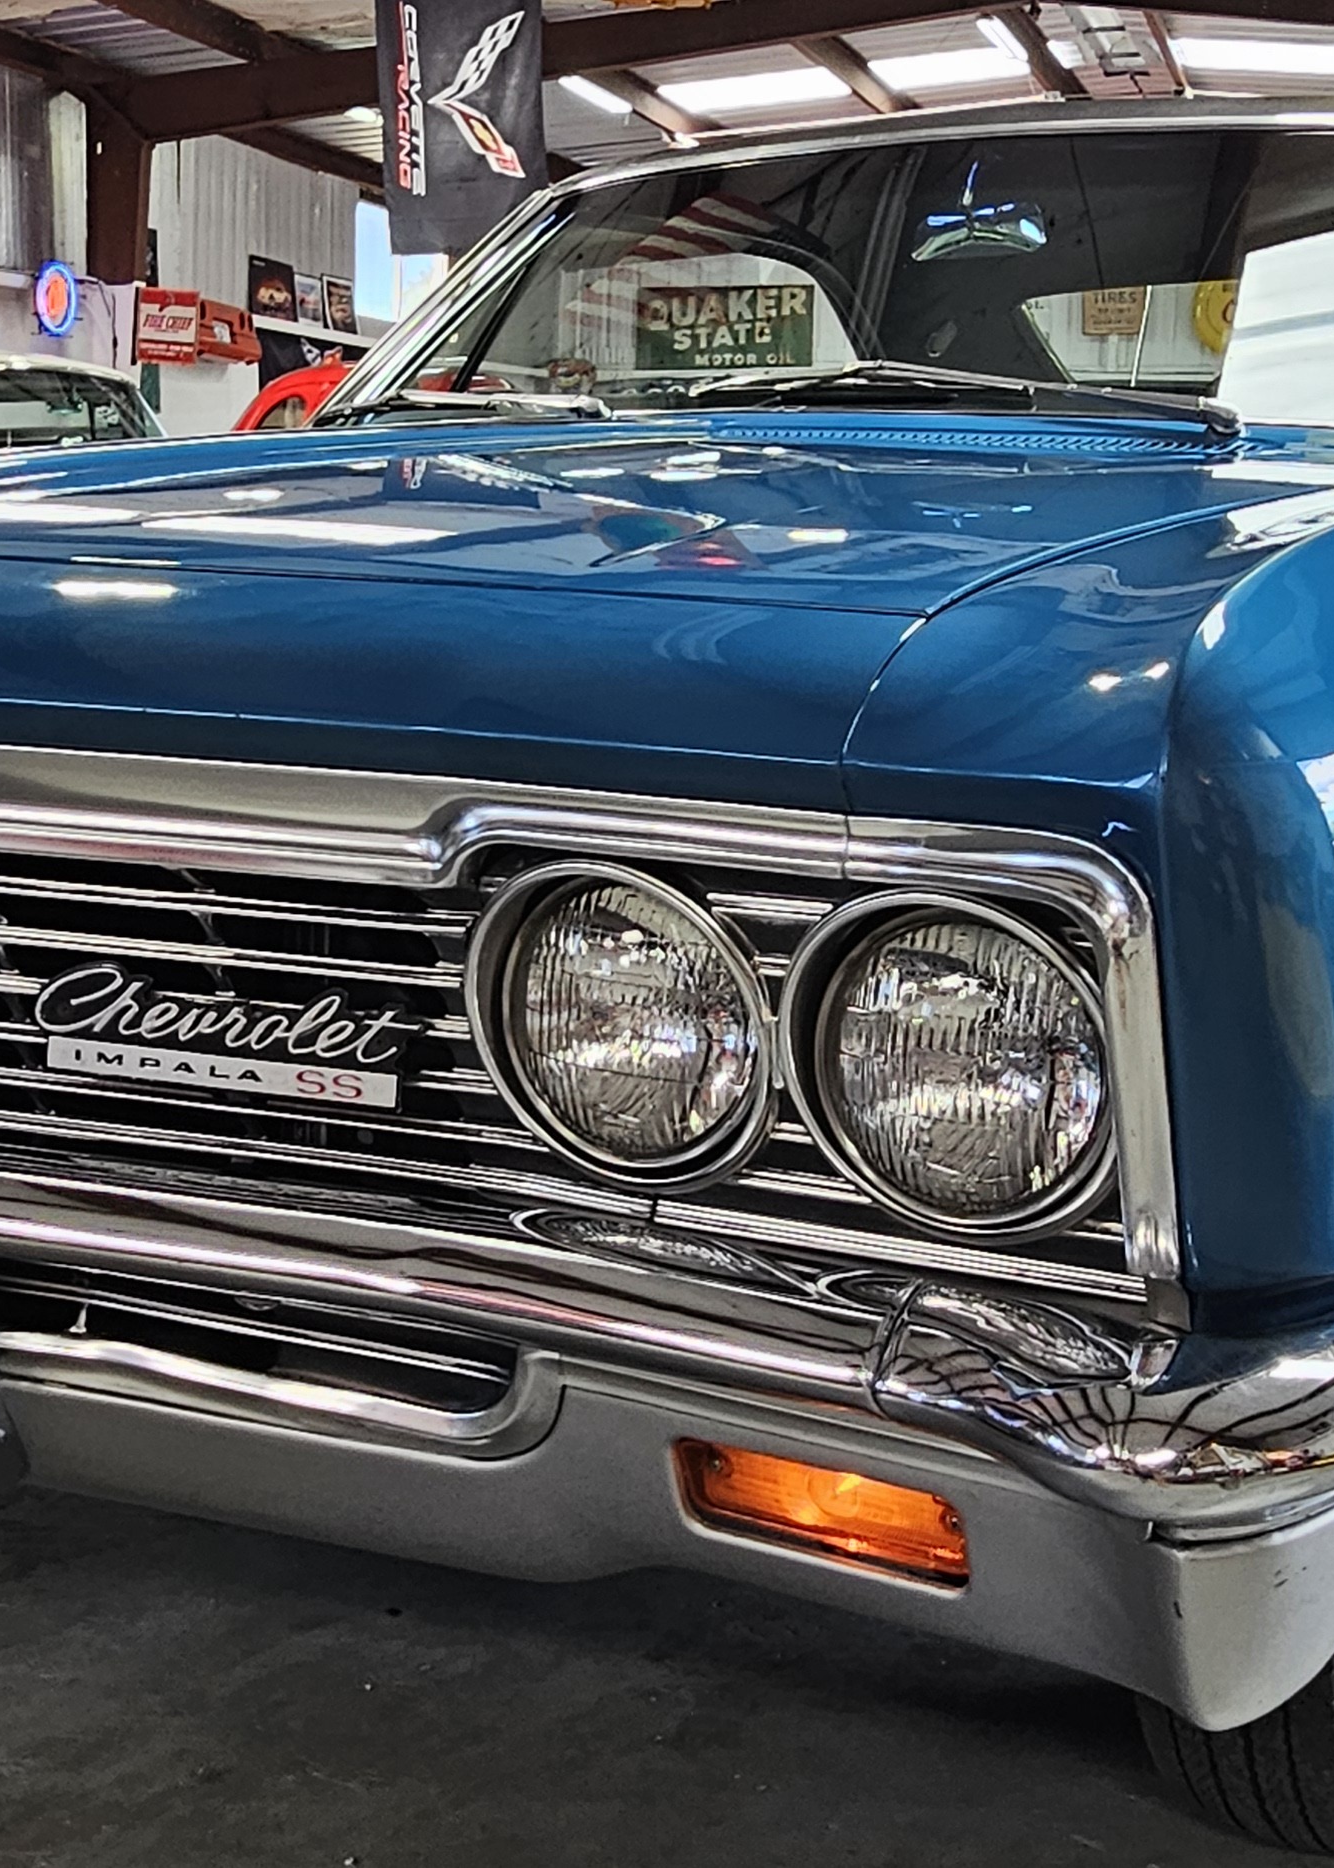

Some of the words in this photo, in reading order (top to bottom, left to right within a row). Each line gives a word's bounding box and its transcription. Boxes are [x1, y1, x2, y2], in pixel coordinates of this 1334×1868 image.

[404, 4, 426, 196] CORVETTE
[397, 63, 411, 190] RACING
[648, 286, 808, 331] QUAKER
[673, 320, 773, 350] STATE
[694, 353, 758, 366] MOTOR
[766, 350, 796, 365] OIL
[35, 966, 422, 1063] Chevrolet
[74, 1048, 262, 1083] IMPALA
[296, 1069, 364, 1099] SS
